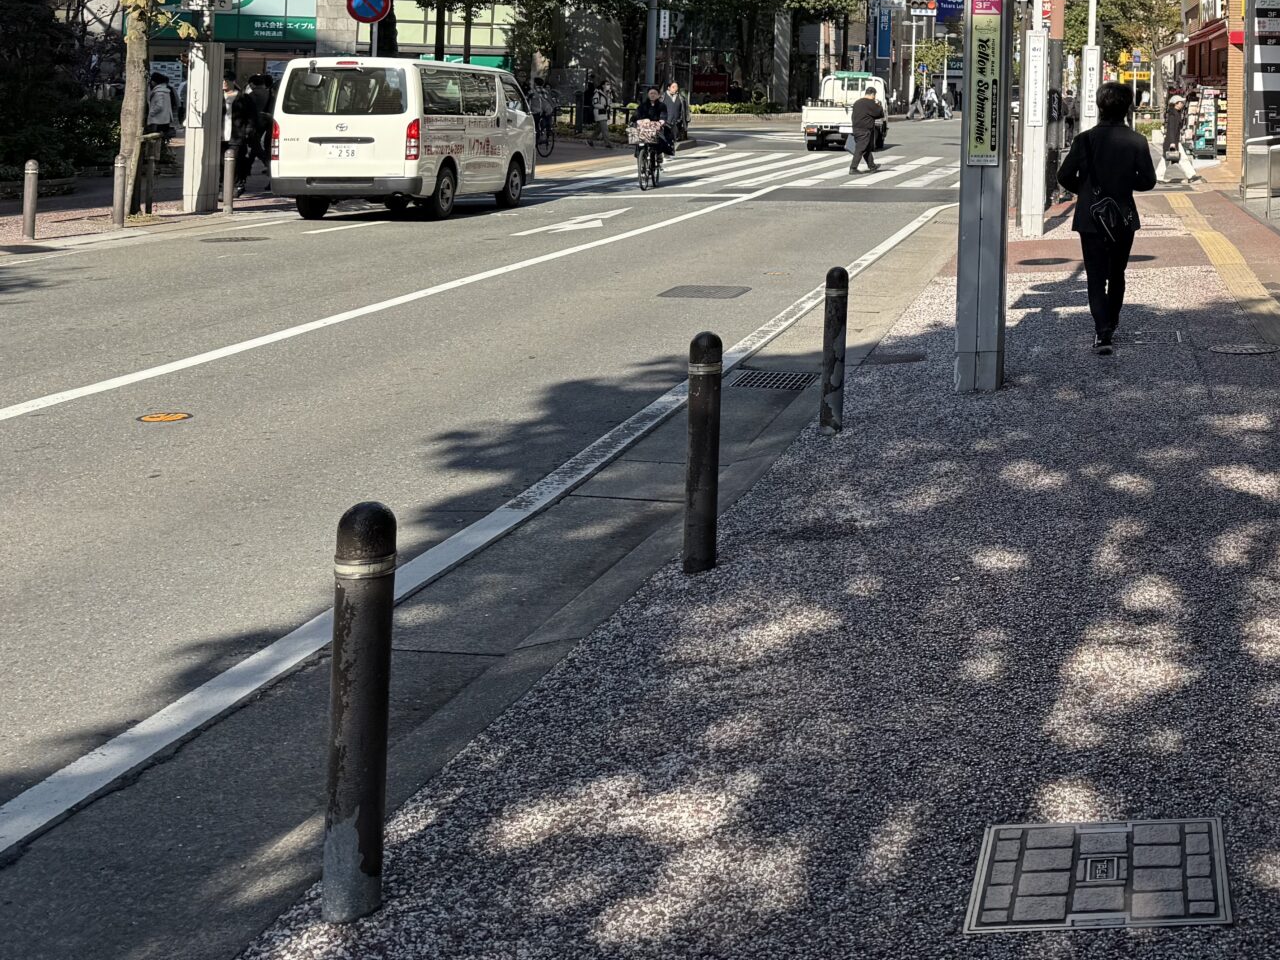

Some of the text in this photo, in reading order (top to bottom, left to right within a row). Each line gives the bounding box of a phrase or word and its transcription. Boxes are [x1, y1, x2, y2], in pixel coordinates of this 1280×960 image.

[286, 22, 315, 30] エイブル
[977, 38, 990, 76] Yellow
[976, 80, 989, 144] Submarine
